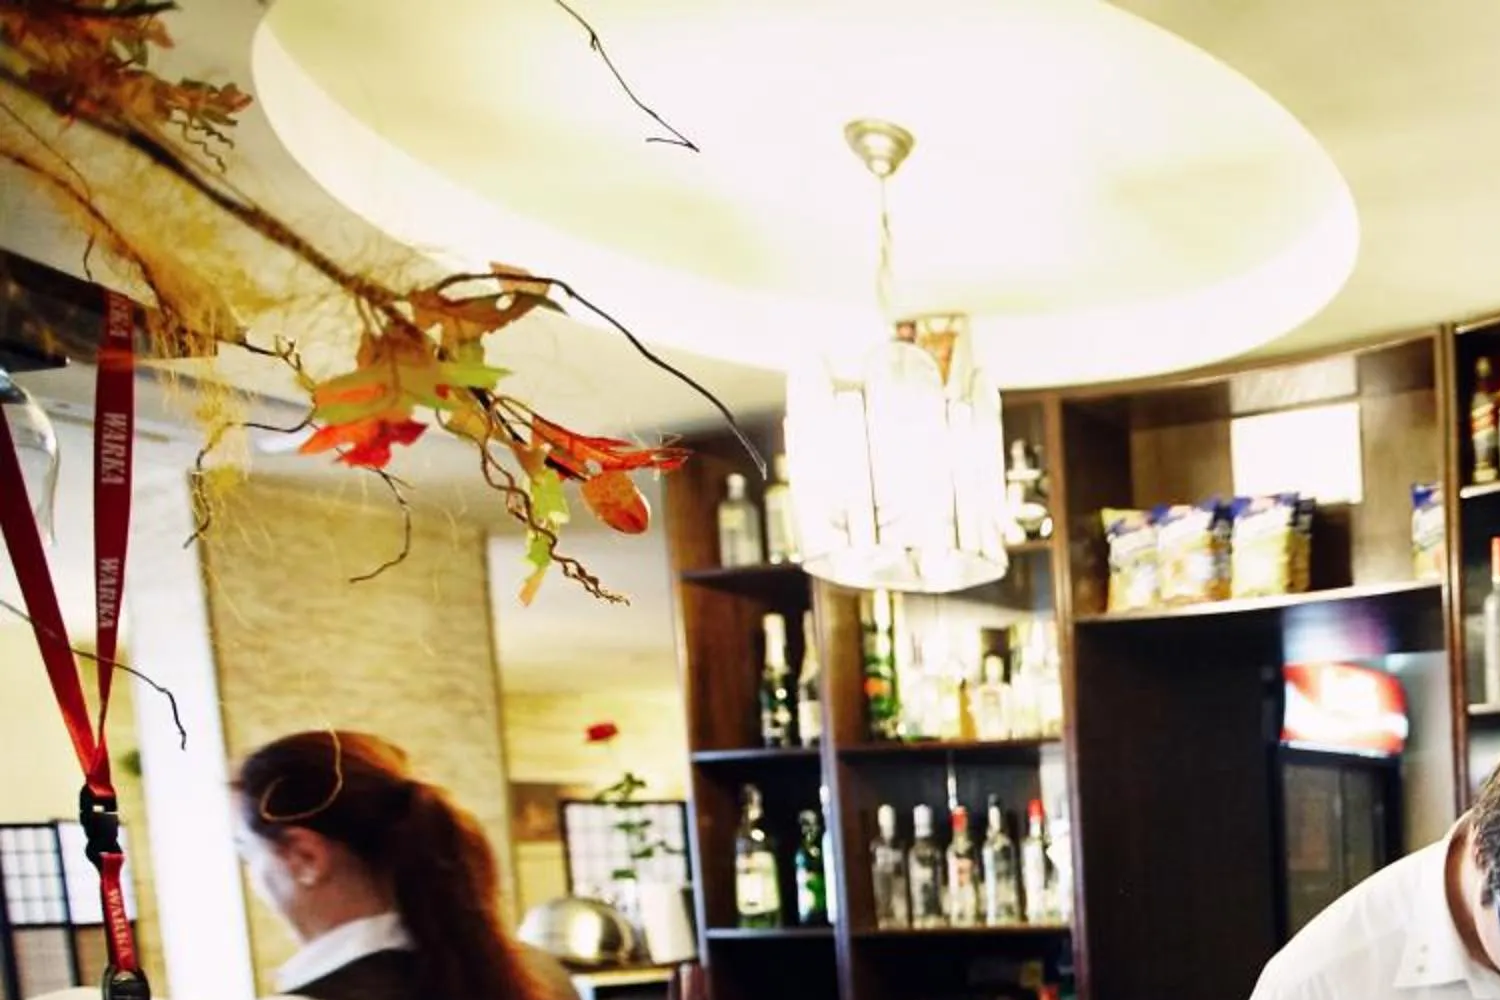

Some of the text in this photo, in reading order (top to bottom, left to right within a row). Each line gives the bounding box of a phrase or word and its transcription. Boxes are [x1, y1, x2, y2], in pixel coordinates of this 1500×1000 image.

[101, 412, 127, 485] WARKA
[99, 557, 120, 629] WARKA
[108, 888, 130, 957] WARKA
